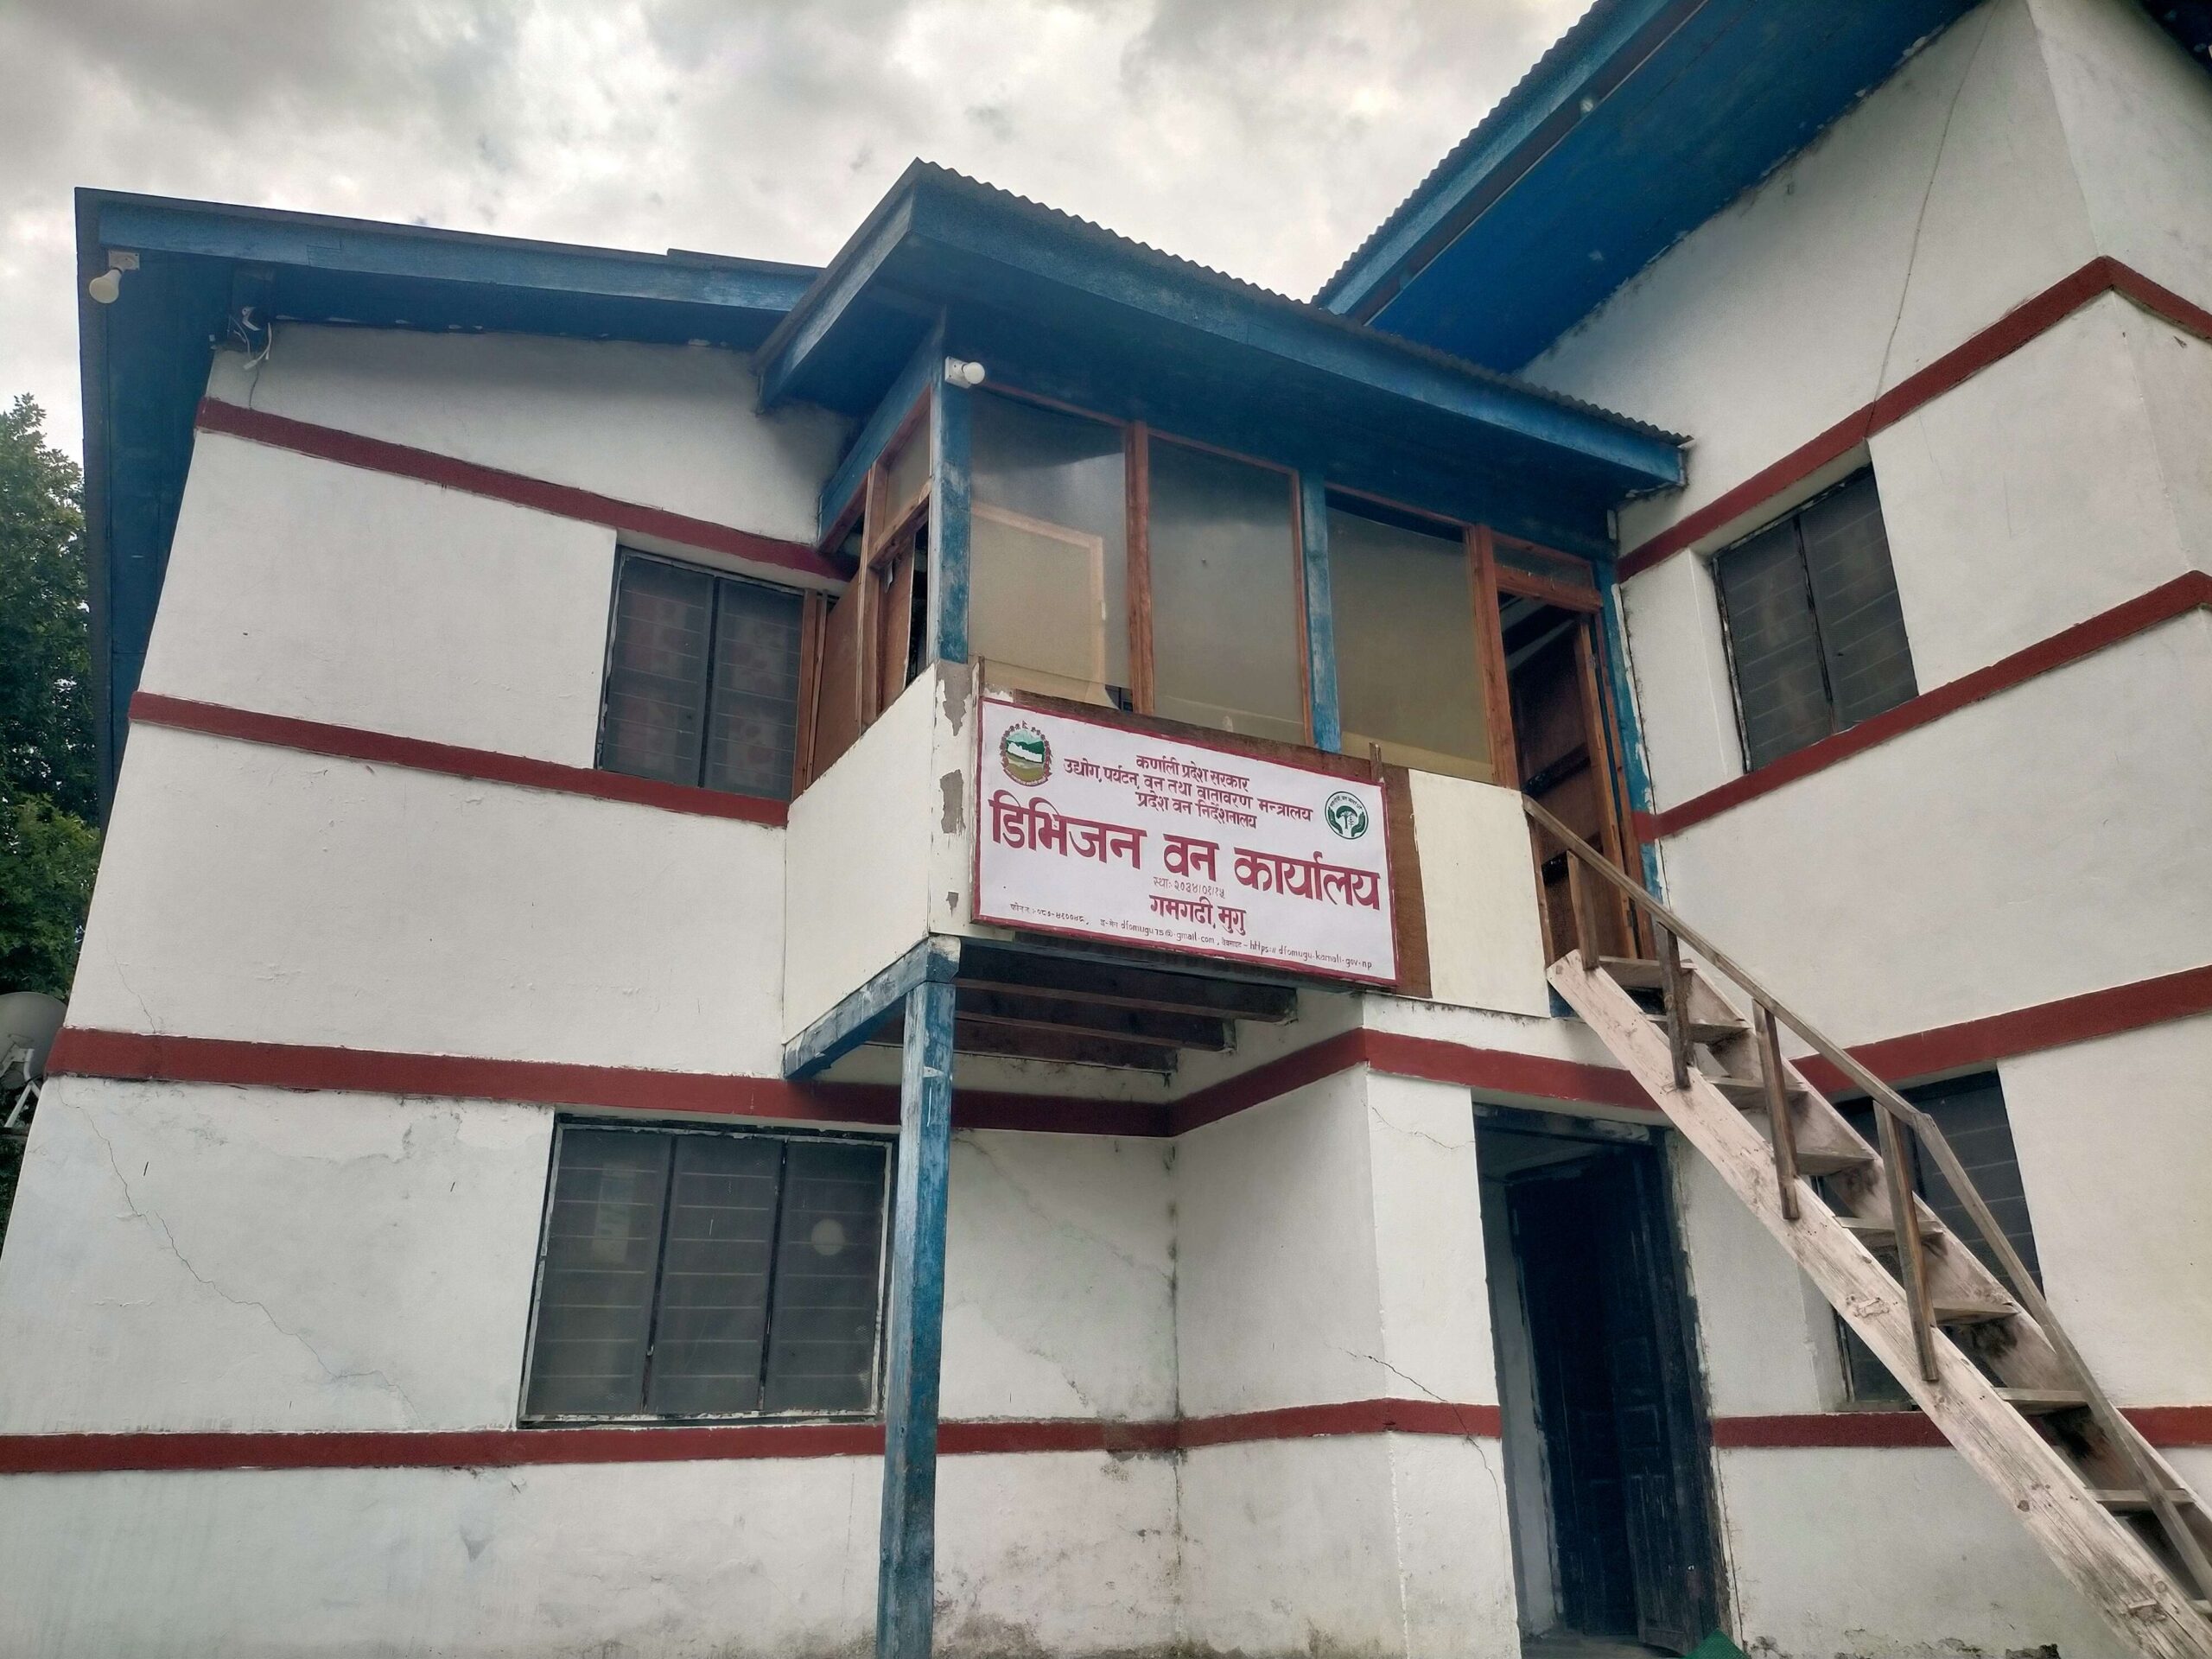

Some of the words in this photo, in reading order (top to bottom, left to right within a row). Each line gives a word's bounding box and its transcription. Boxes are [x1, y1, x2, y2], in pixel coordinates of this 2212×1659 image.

[1064, 758, 1103, 783] उद्योग,
[1103, 766, 1140, 790] पर्यटन,
[1143, 774, 1165, 791] वन
[1168, 779, 1192, 797] तथा
[1197, 785, 1253, 809] वातावरण
[1257, 798, 1313, 822] मन्त्रालय
[1136, 755, 1181, 775] कर्णाली
[1182, 760, 1208, 783] प्रदेश
[1210, 769, 1249, 792] सरकार
[1135, 791, 1169, 811] प्रदेश
[1172, 798, 1192, 815] वन
[1195, 800, 1257, 829] निर्देशनालय
[988, 790, 1147, 870] डिभिजन
[1163, 834, 1220, 881] वन
[1234, 848, 1381, 911] कार्यालय
[1217, 906, 1246, 936] मुगु
